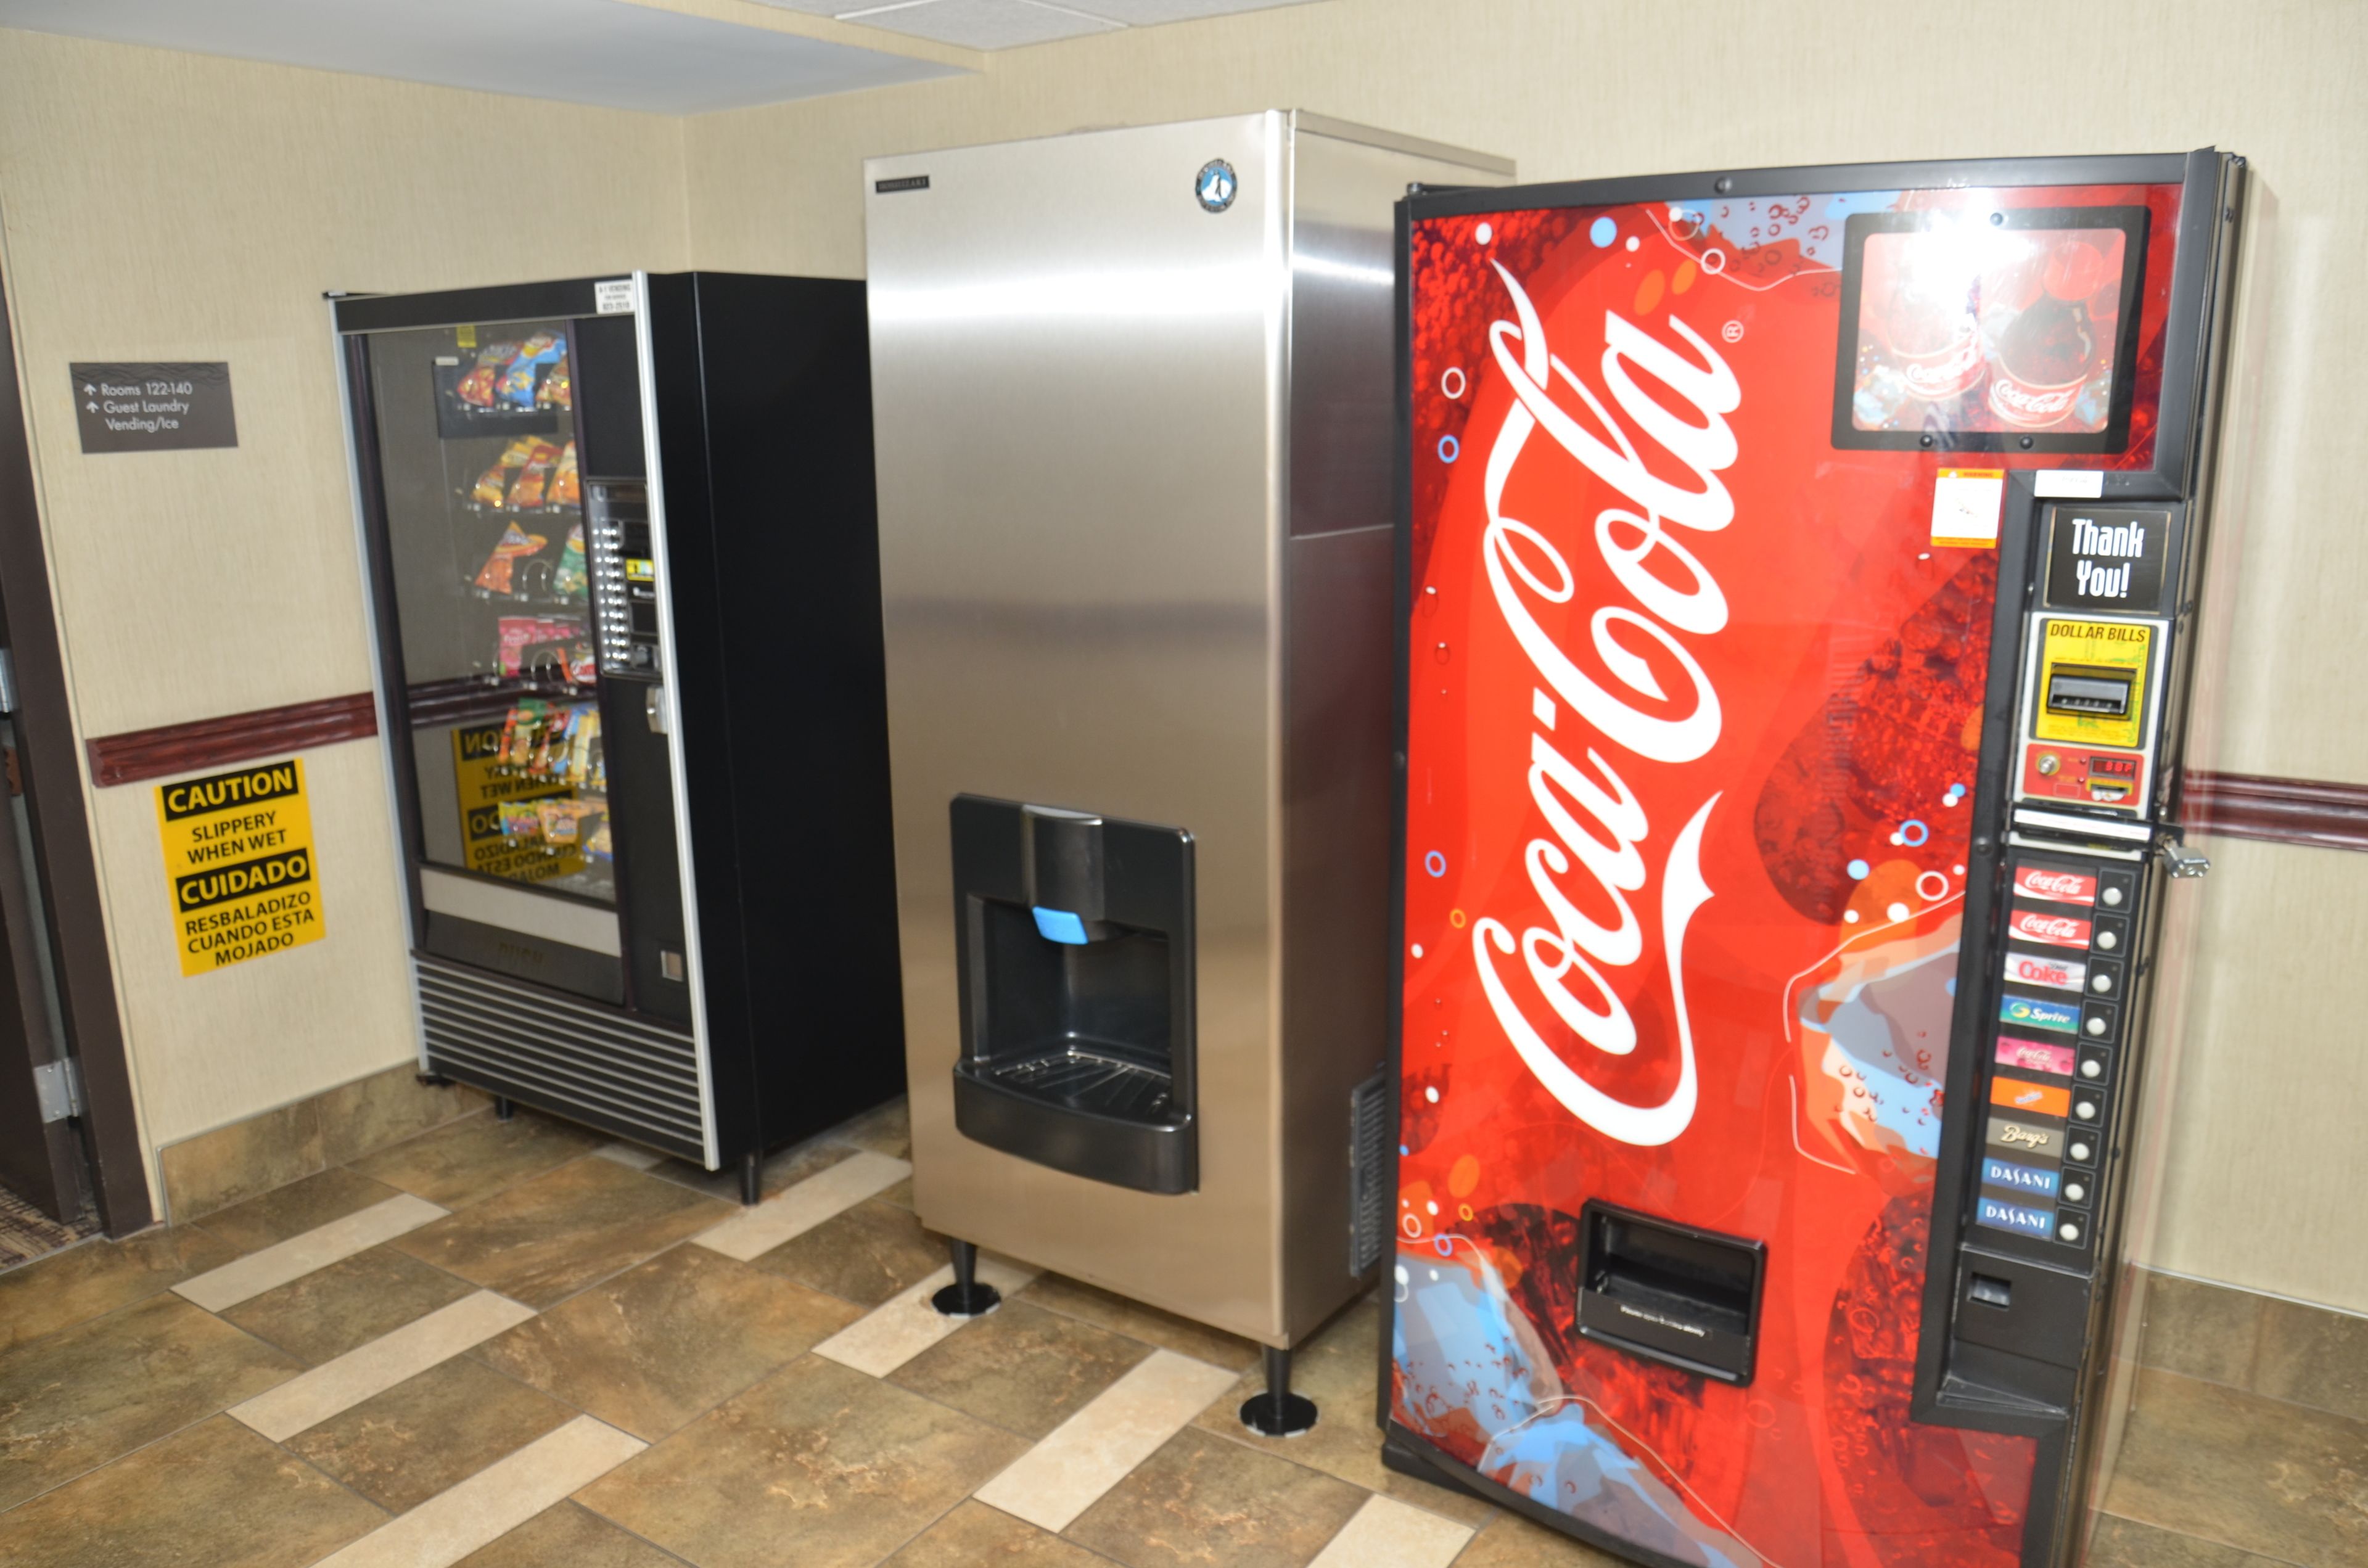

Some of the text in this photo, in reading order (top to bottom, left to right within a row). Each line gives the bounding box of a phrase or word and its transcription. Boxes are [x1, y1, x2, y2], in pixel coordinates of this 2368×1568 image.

[101, 381, 193, 396] Rooms 122-140
[1994, 379, 2076, 414] Coca-Cola
[103, 398, 189, 415] Guest Laundry
[105, 416, 179, 433] Vending/Ice
[2071, 517, 2145, 558] Thank
[2076, 559, 2131, 598] You!
[2050, 623, 2146, 642] DOLLAR BILLS
[1473, 257, 1744, 1147] Coca-Cola
[167, 766, 294, 813] CAUTION
[191, 810, 276, 843] SLIPPERY
[187, 829, 287, 865] WHEN WET
[181, 855, 308, 905] CUIDADO
[2024, 869, 2087, 895] Coca-Cola
[186, 891, 311, 936] RESBALADIZO
[2020, 913, 2080, 938] Coca-Cola
[187, 909, 314, 954] CUANDO ESTA
[216, 932, 294, 967] MOJADO
[2018, 960, 2068, 986] Coke
[2029, 1008, 2071, 1024] Sprite
[1990, 1165, 2051, 1189] DASANI
[1985, 1205, 2045, 1229] DASANI
